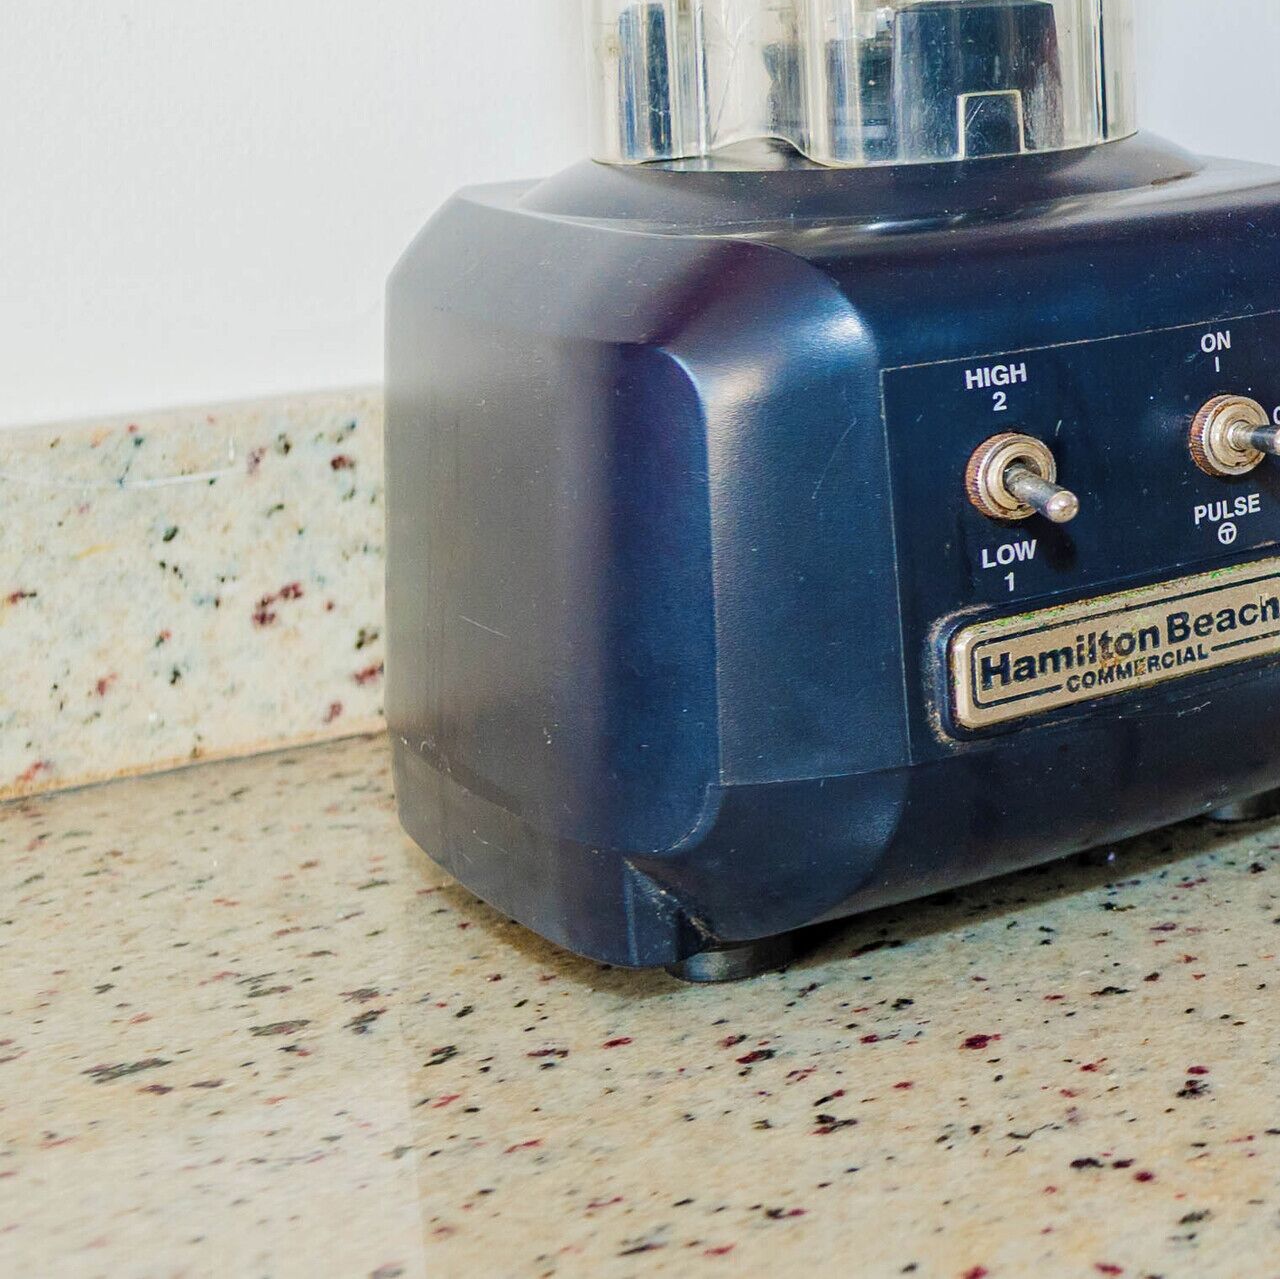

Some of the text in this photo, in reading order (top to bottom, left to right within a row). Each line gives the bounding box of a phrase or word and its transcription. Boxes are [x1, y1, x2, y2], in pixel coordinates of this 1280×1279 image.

[1200, 330, 1231, 353] ON
[965, 362, 1027, 390] HIGH
[992, 391, 1007, 411] 2
[1194, 494, 1261, 524] PULSE
[982, 539, 1037, 569] LOW
[1004, 572, 1014, 592] 1
[980, 595, 1280, 692] Hamilton Beach
[1065, 642, 1209, 694] COMMERCIAL
